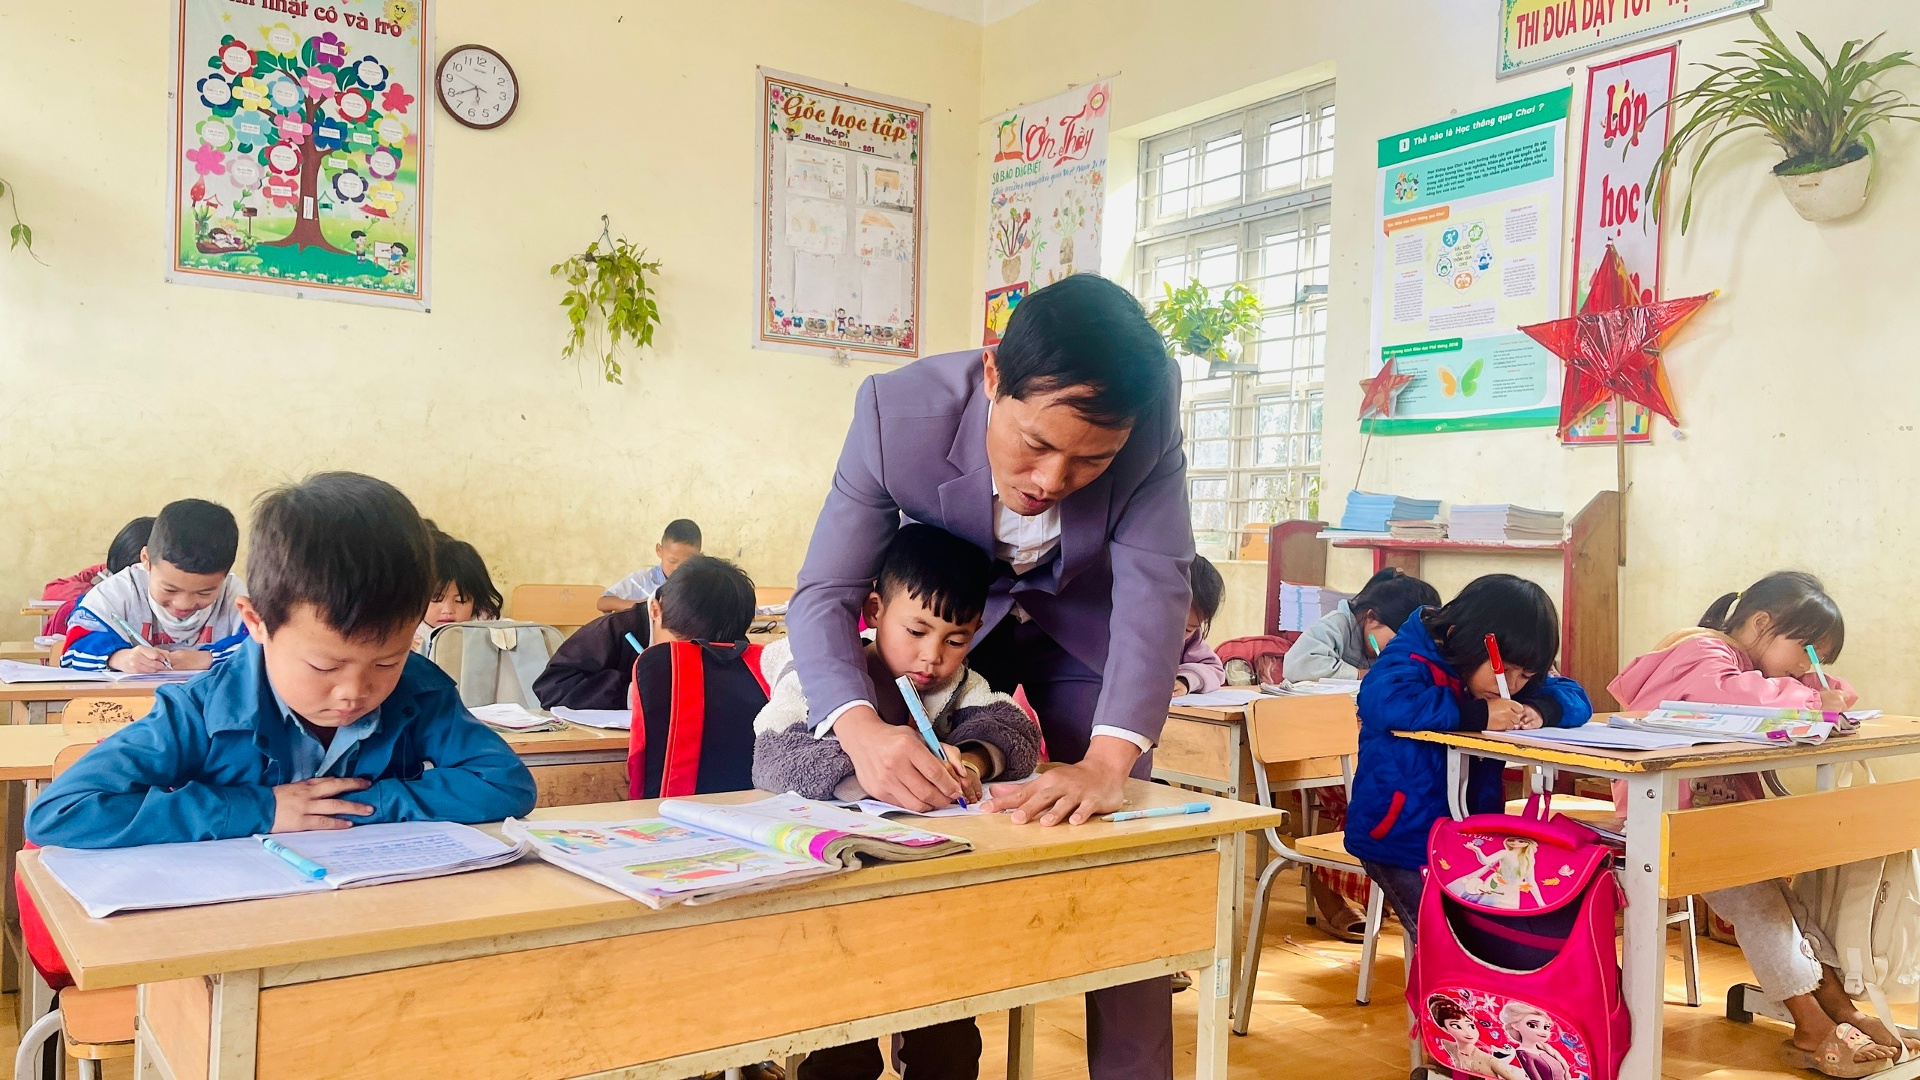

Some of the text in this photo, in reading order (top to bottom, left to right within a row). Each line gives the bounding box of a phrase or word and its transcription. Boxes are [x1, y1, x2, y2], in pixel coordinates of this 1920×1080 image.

[314, 6, 338, 23] cô
[343, 12, 369, 31] và
[375, 17, 402, 37] trò
[1517, 10, 1540, 49] THI
[1543, 0, 1577, 42] ĐUA
[464, 56, 472, 66] 11
[477, 56, 488, 67] 12
[453, 62, 463, 72] 10
[493, 66, 496, 75] 1
[446, 73, 454, 83] 9
[497, 77, 506, 87] 2
[447, 87, 456, 98] 8
[499, 92, 507, 101] 3
[456, 100, 464, 109] 7
[493, 103, 500, 112] 4
[467, 108, 476, 118] 6
[482, 108, 490, 118] 5
[1604, 79, 1648, 147] Lớp
[781, 96, 908, 143] Góc học tập
[1429, 131, 1444, 142] nào
[1445, 128, 1453, 137] là
[1455, 125, 1470, 135] Học
[1472, 118, 1496, 130] thông
[1497, 112, 1513, 124] qua
[1515, 105, 1536, 117] Chơi
[1538, 102, 1545, 111] ?
[805, 133, 822, 143] Năm
[1600, 173, 1641, 237] học
